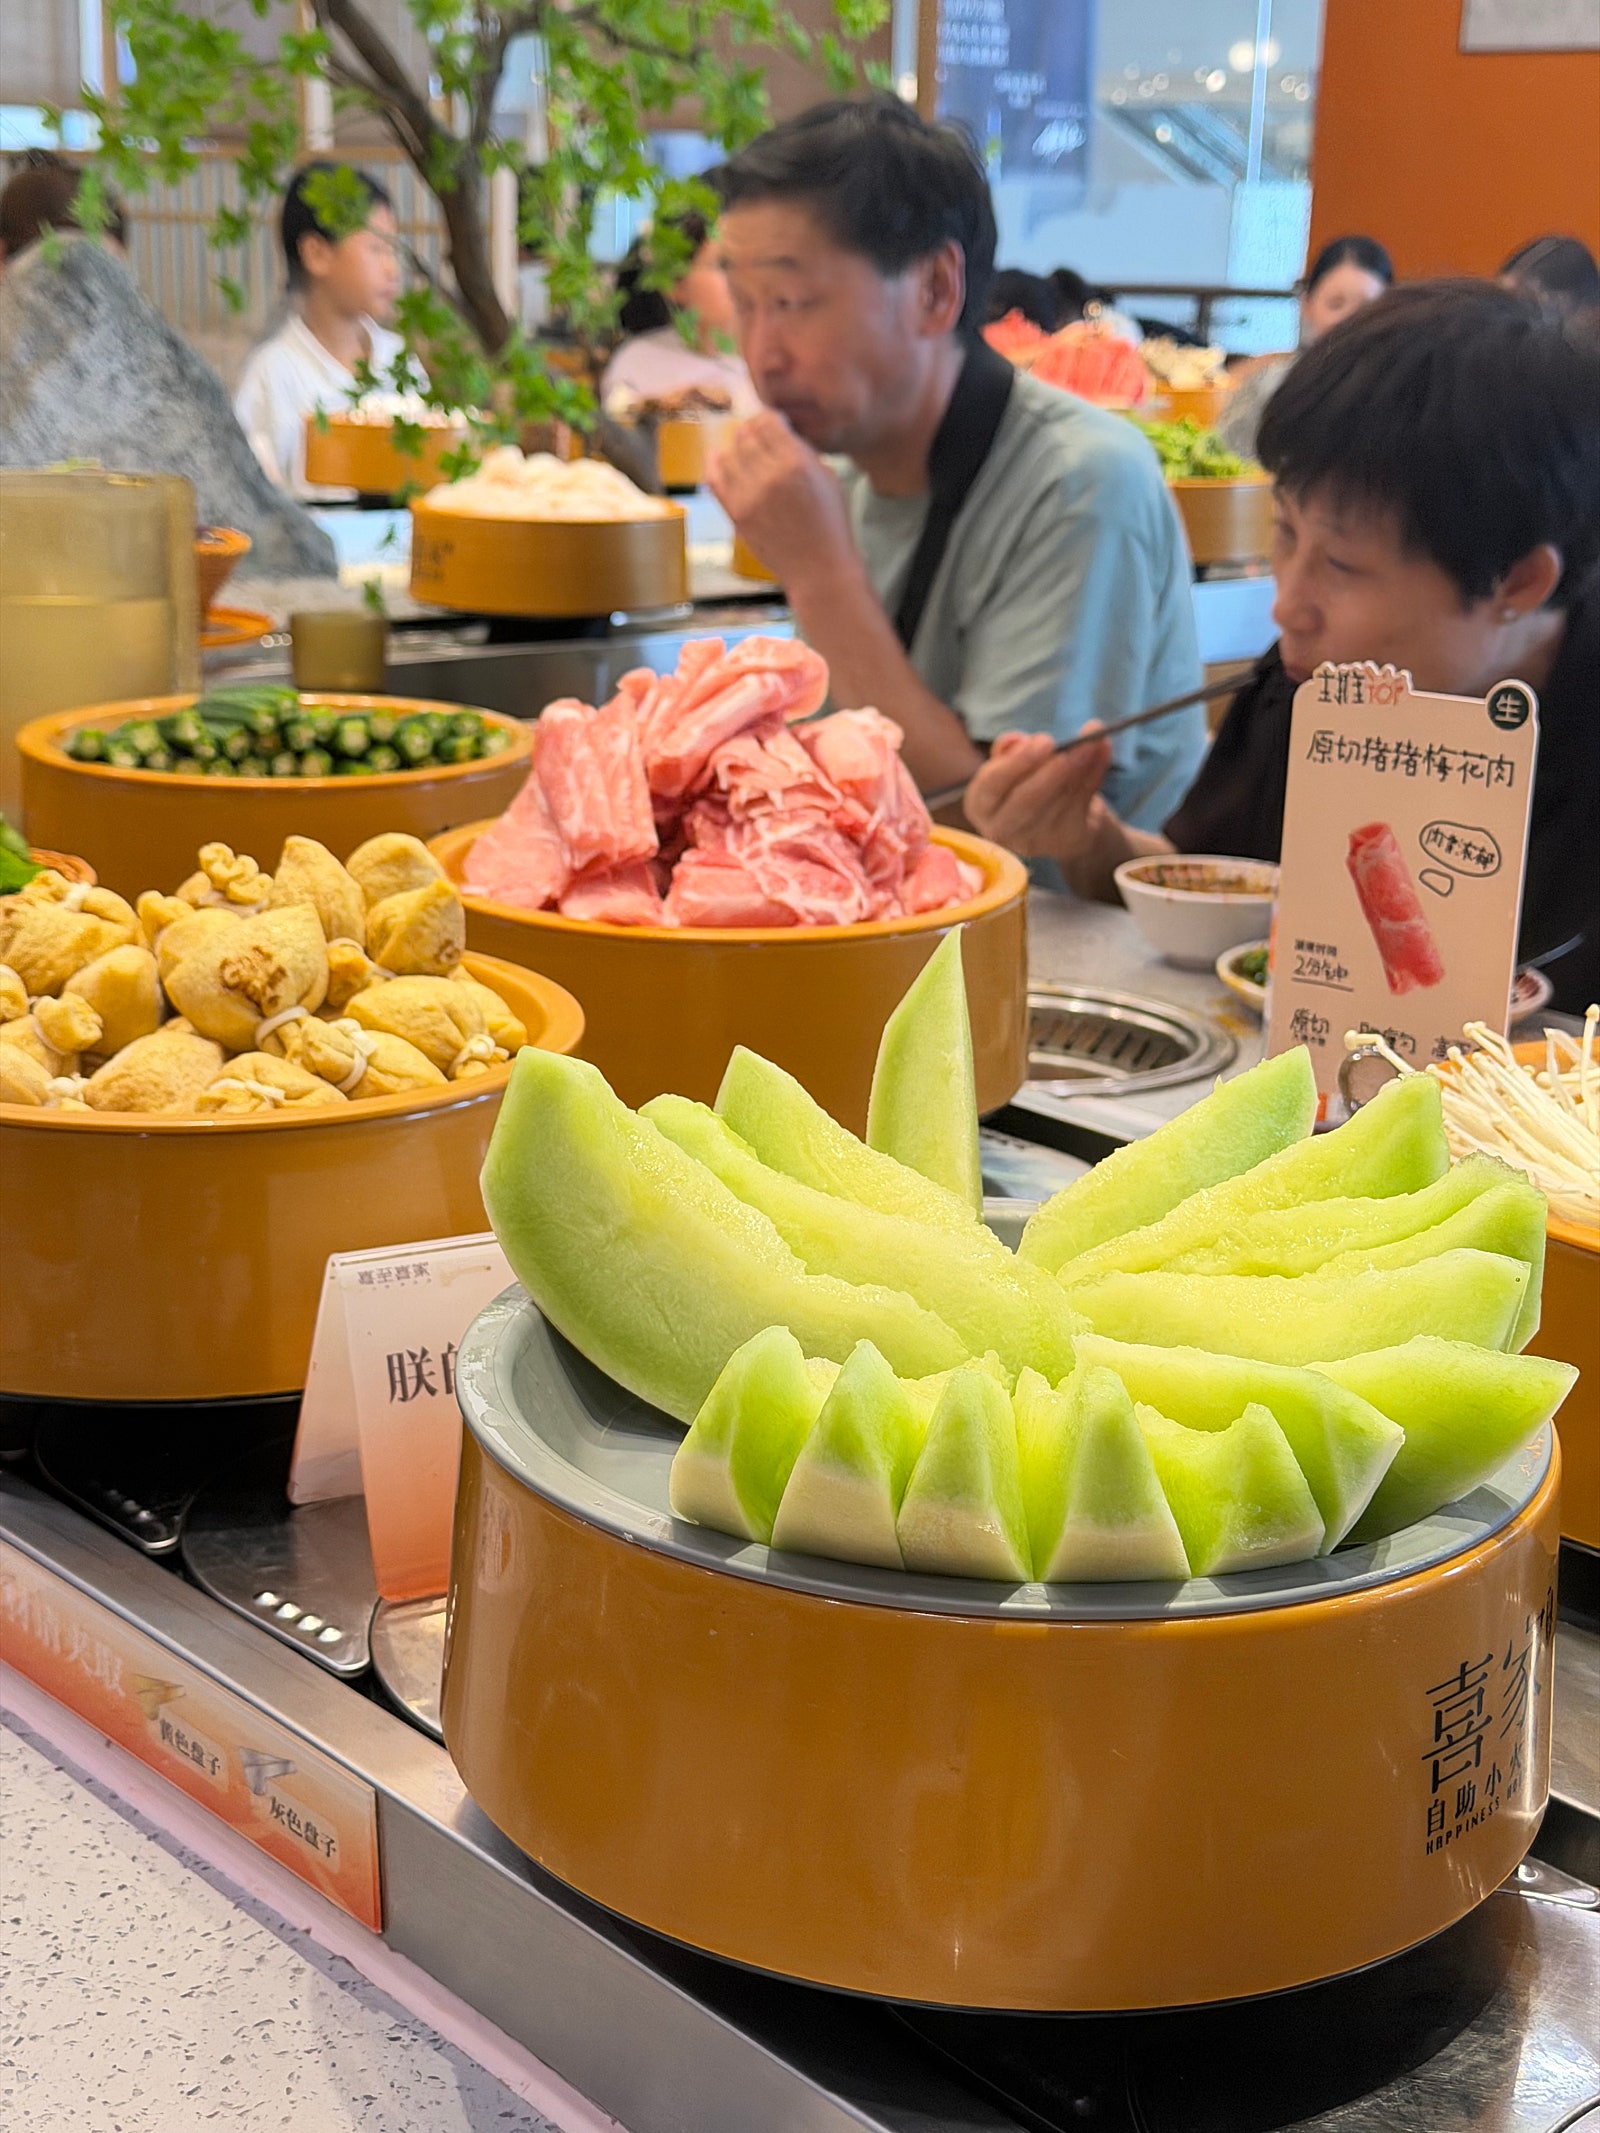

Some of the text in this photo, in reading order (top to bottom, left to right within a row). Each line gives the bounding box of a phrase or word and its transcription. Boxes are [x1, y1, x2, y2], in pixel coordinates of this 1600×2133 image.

[1495, 692, 1522, 724] 生
[1306, 729, 1515, 789] 原切猪猪梅花肉
[269, 1797, 337, 1858] 灰色盘子
[1425, 1796, 1500, 1856] HAPPINESS
